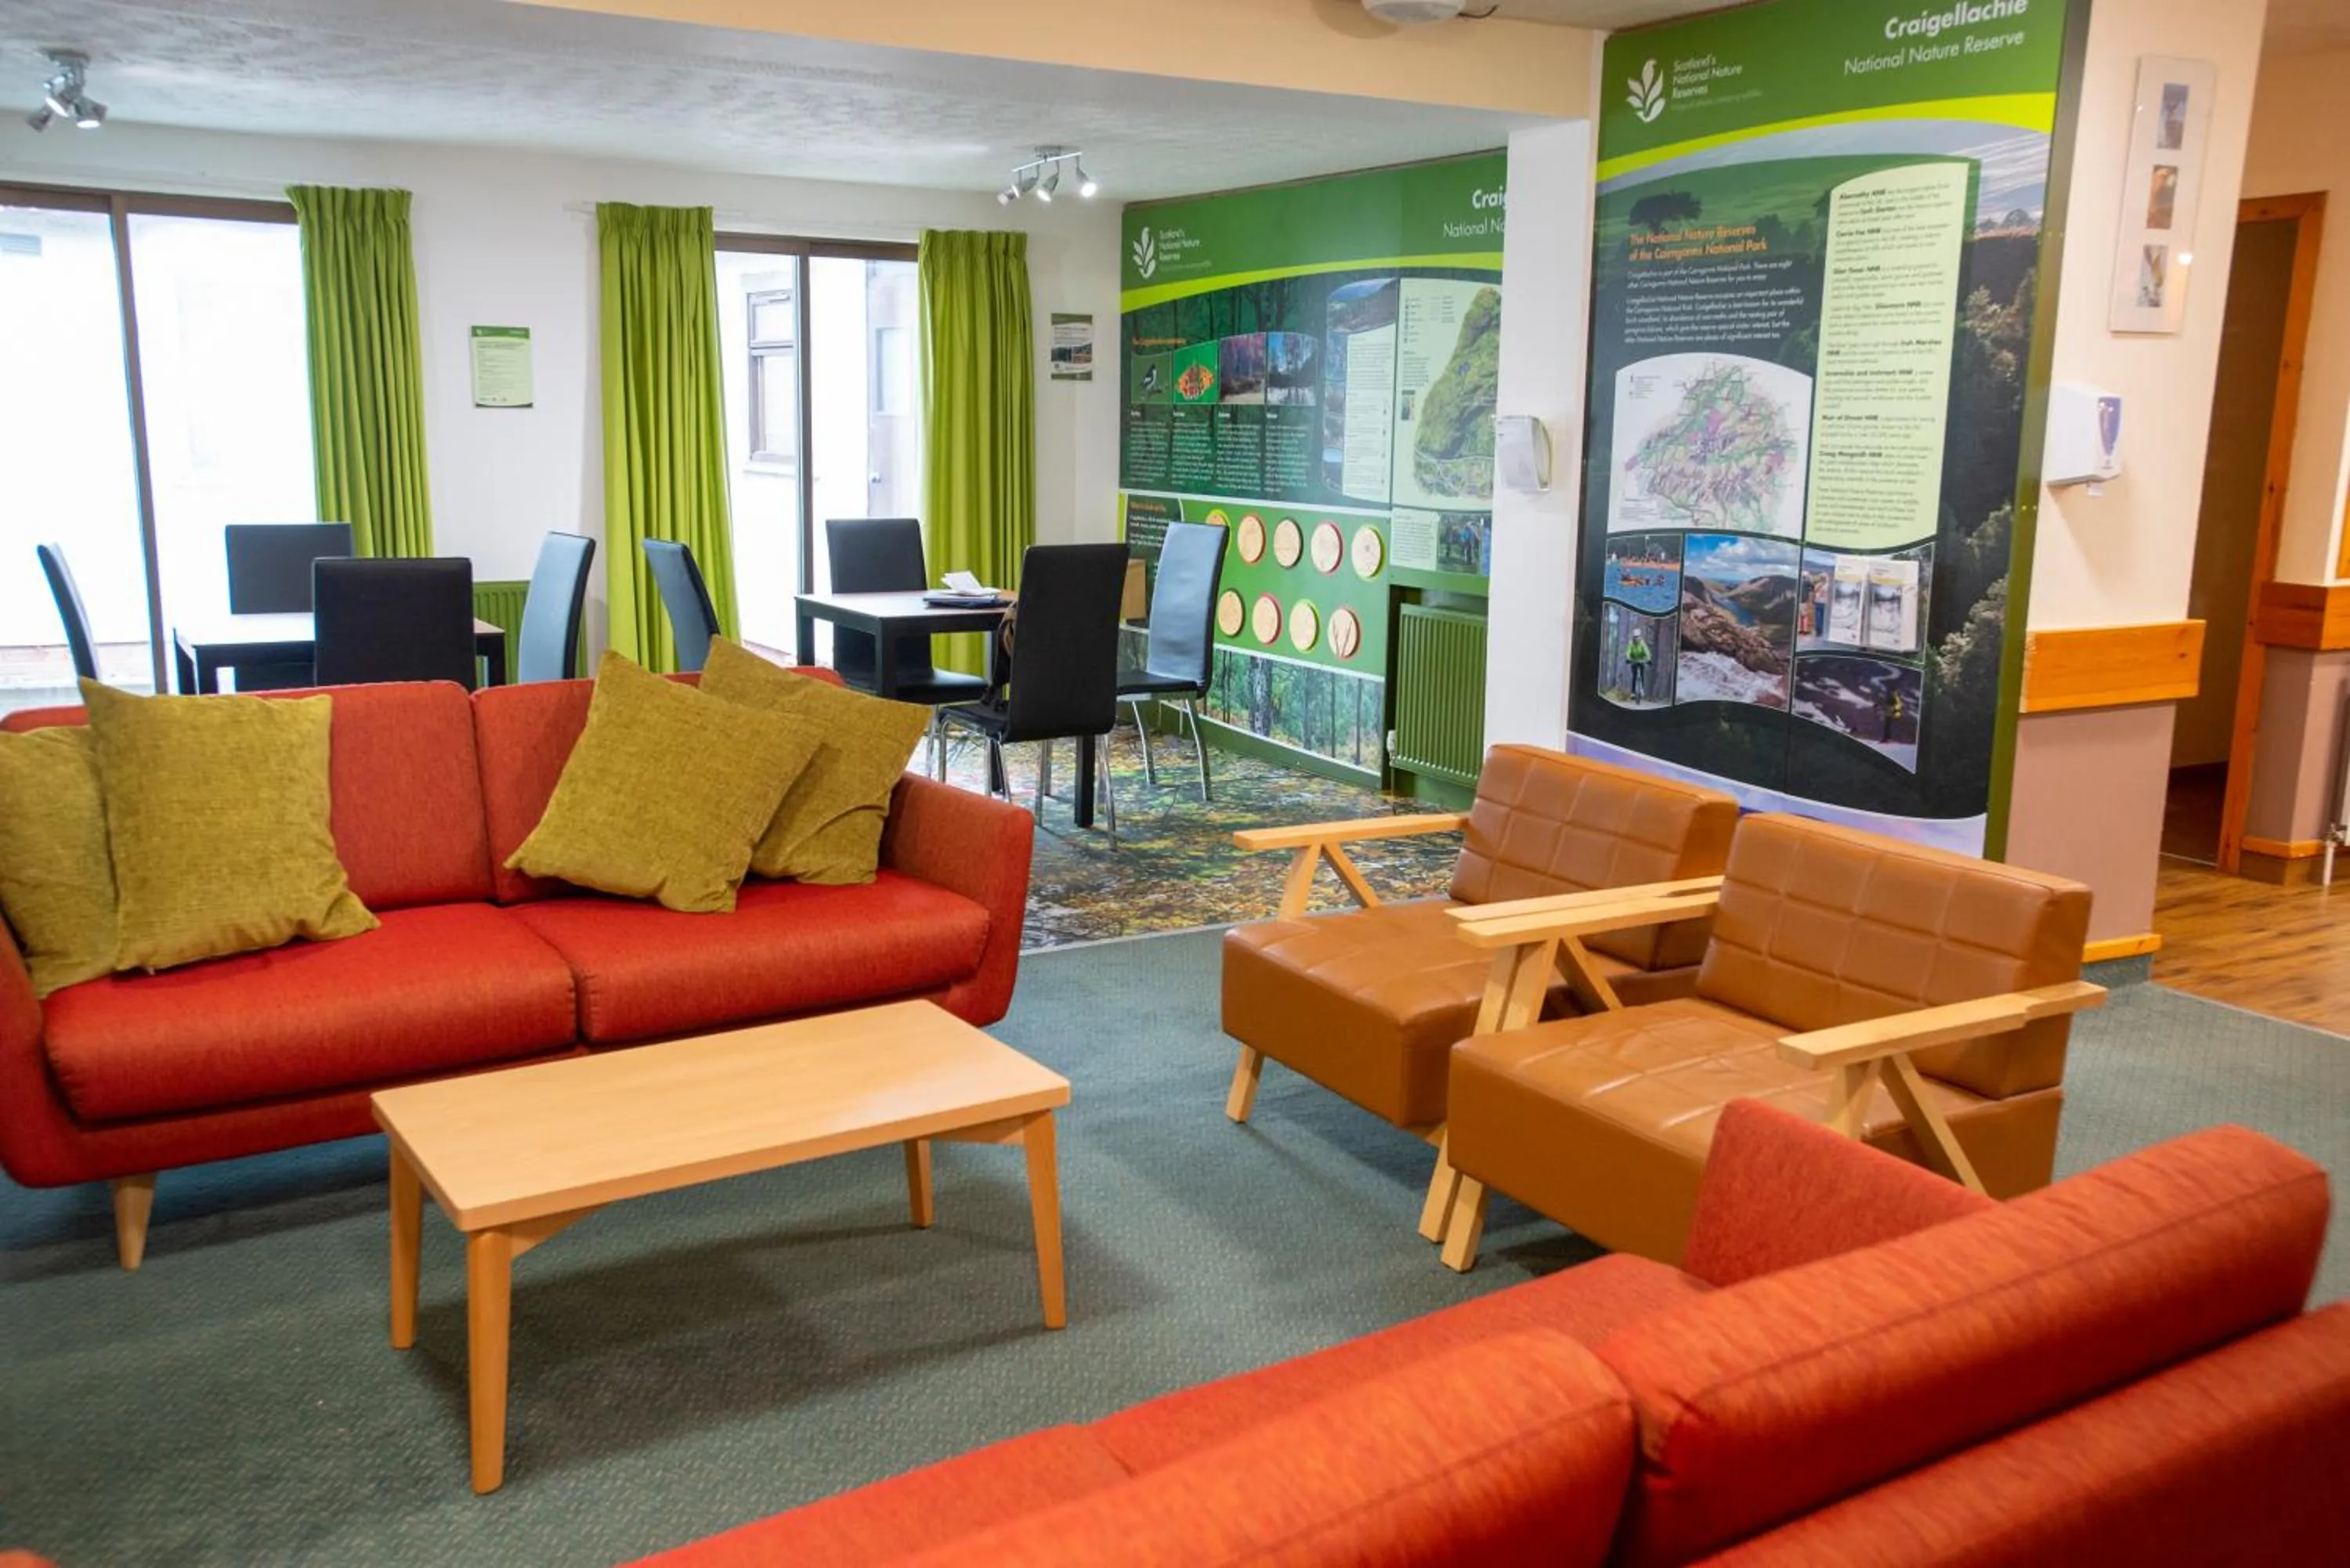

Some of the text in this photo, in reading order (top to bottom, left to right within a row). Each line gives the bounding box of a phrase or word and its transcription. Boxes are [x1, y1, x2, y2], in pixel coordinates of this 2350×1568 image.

[1885, 0, 2027, 38] Craigellachie
[1844, 31, 2025, 75] National Nature Reserve
[1443, 216, 1488, 238] National
